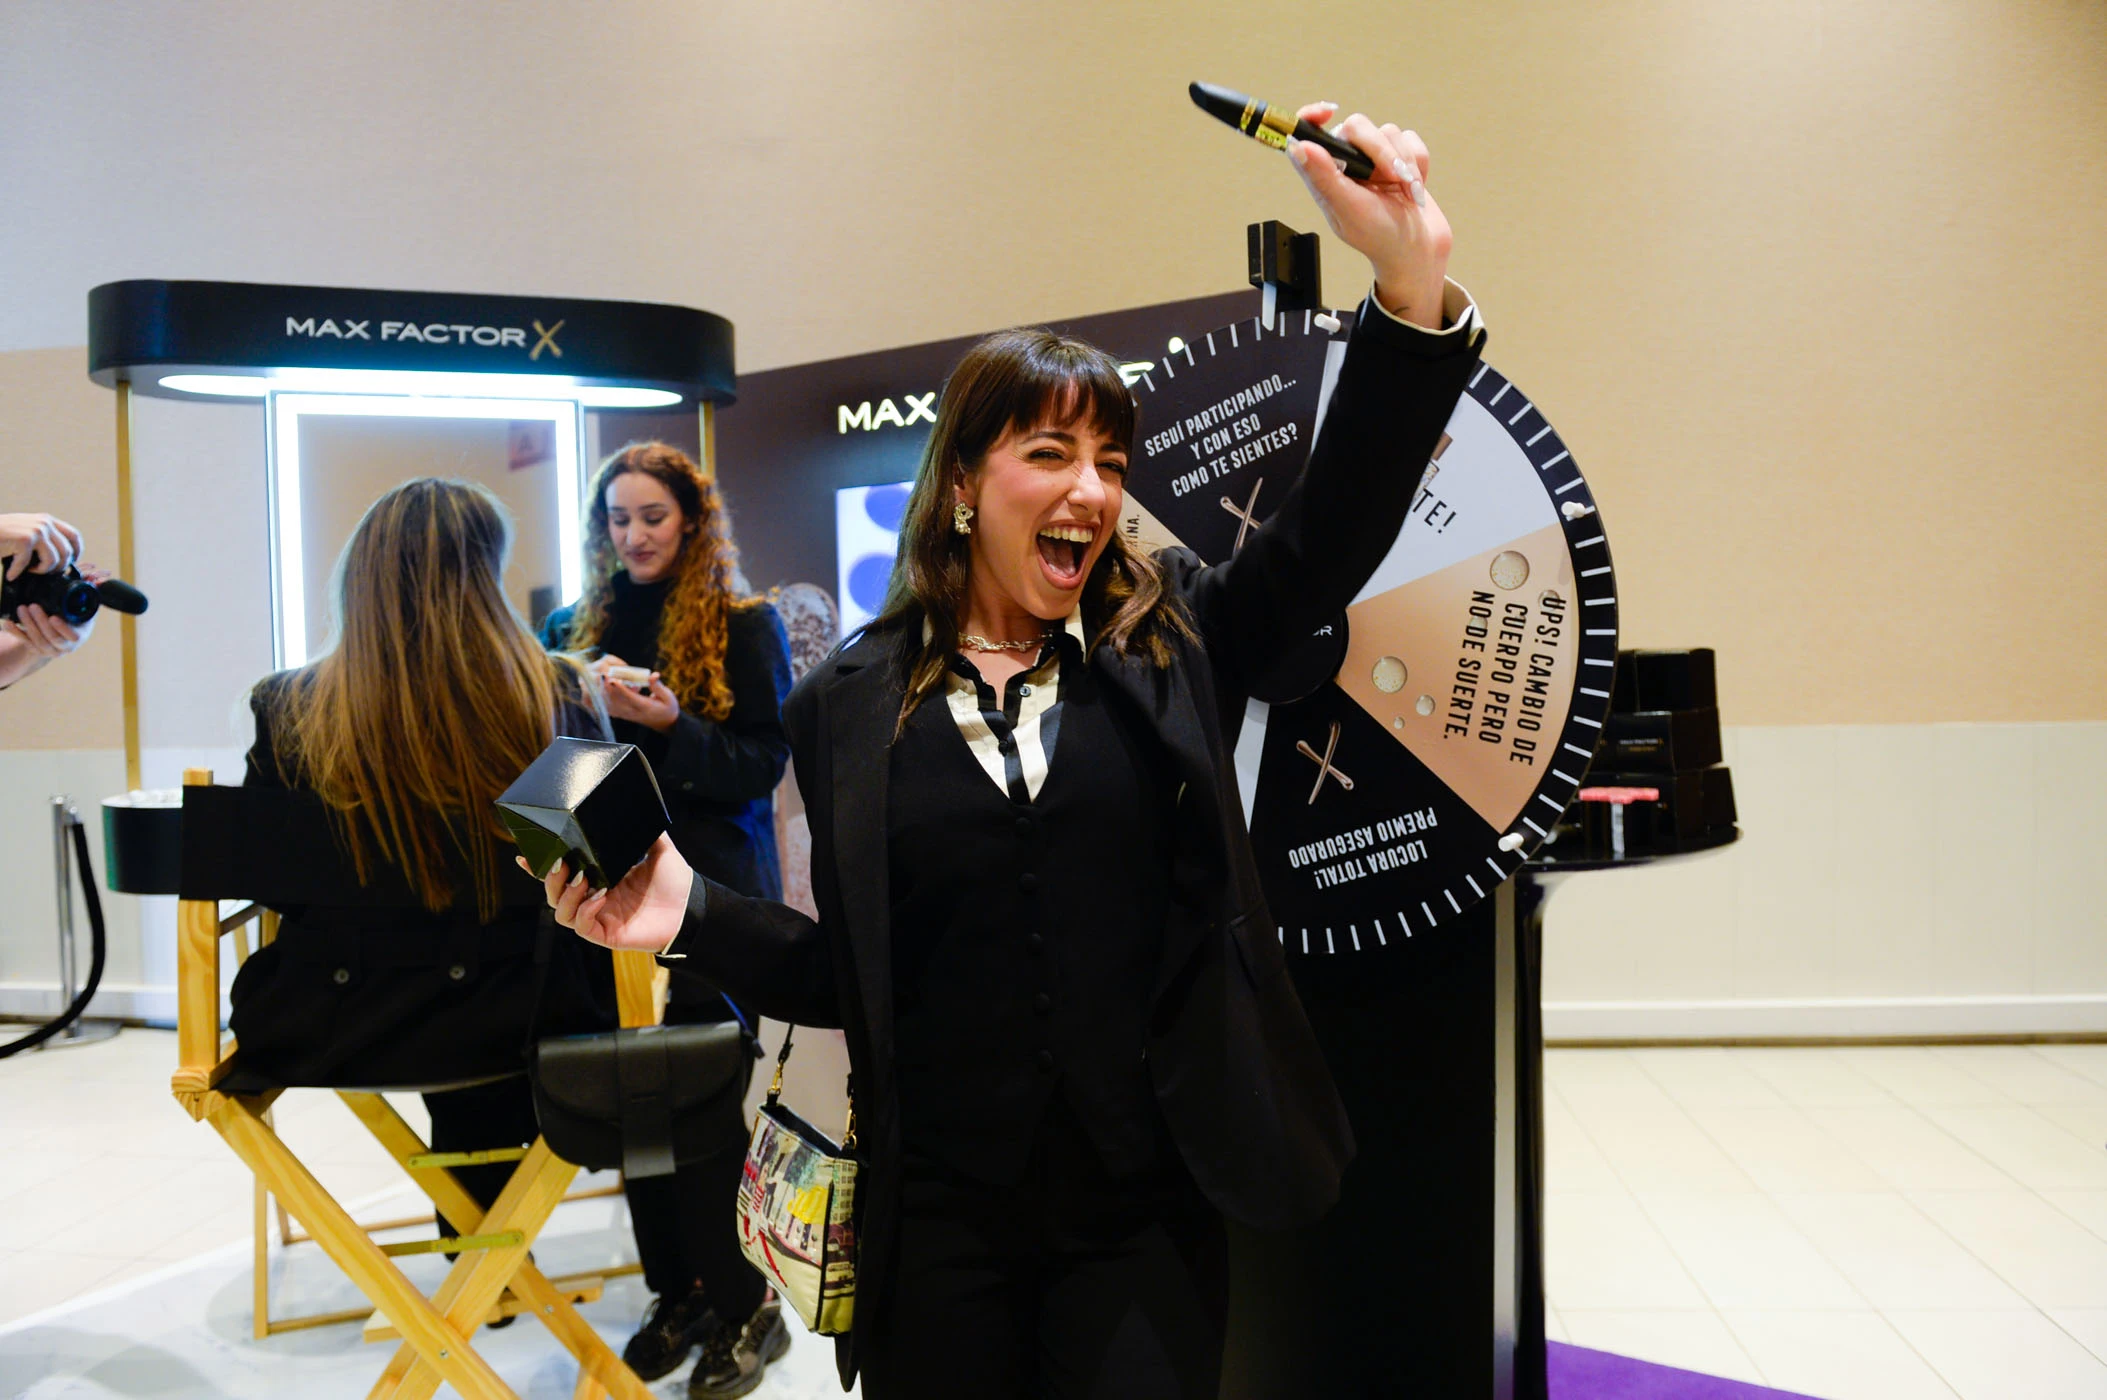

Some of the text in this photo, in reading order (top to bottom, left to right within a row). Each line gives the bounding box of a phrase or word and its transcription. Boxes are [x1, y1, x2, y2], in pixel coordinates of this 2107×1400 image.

[286, 317, 371, 341] MAX
[381, 321, 527, 348] FACTOR
[838, 391, 937, 435] MAX
[1144, 420, 1185, 457] SEGUÍ
[1185, 374, 1297, 437] PARTICIPANDO...
[1190, 413, 1261, 460] Y CON ESO
[1171, 422, 1299, 497] COMO TE SIENTES?
[1443, 590, 1495, 739] NO DE SUERTE.
[1478, 602, 1528, 744] CUERPO PERO
[1509, 596, 1567, 766] UPS! CAMBIO DE
[1288, 807, 1438, 869] PREMIO ASEGURADO
[1313, 839, 1428, 890] LOCURA TOTAL!
